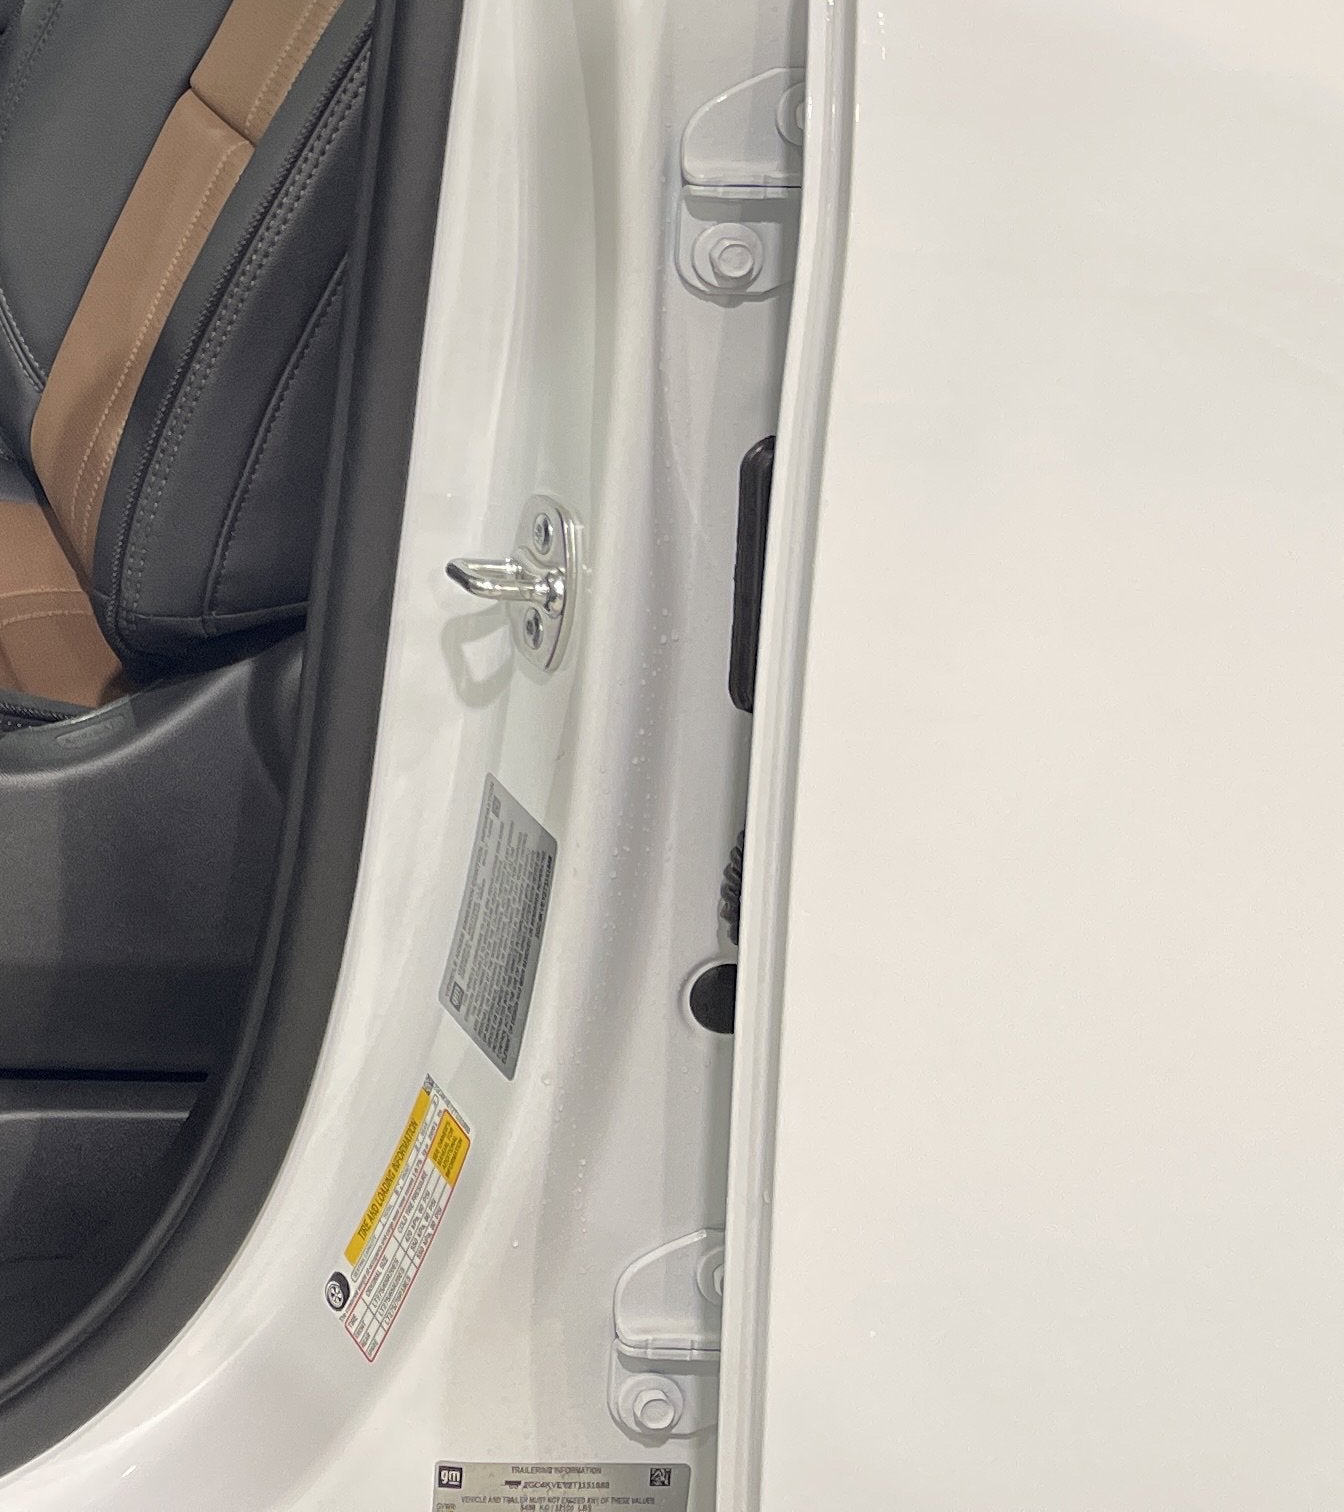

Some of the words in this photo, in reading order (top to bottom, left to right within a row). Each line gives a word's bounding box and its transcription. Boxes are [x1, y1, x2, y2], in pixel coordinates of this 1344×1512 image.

[357, 1220, 371, 1241] TIRE
[365, 1202, 379, 1223] AND
[374, 1168, 395, 1206] LOADING
[390, 1118, 419, 1173] INFORMATION
